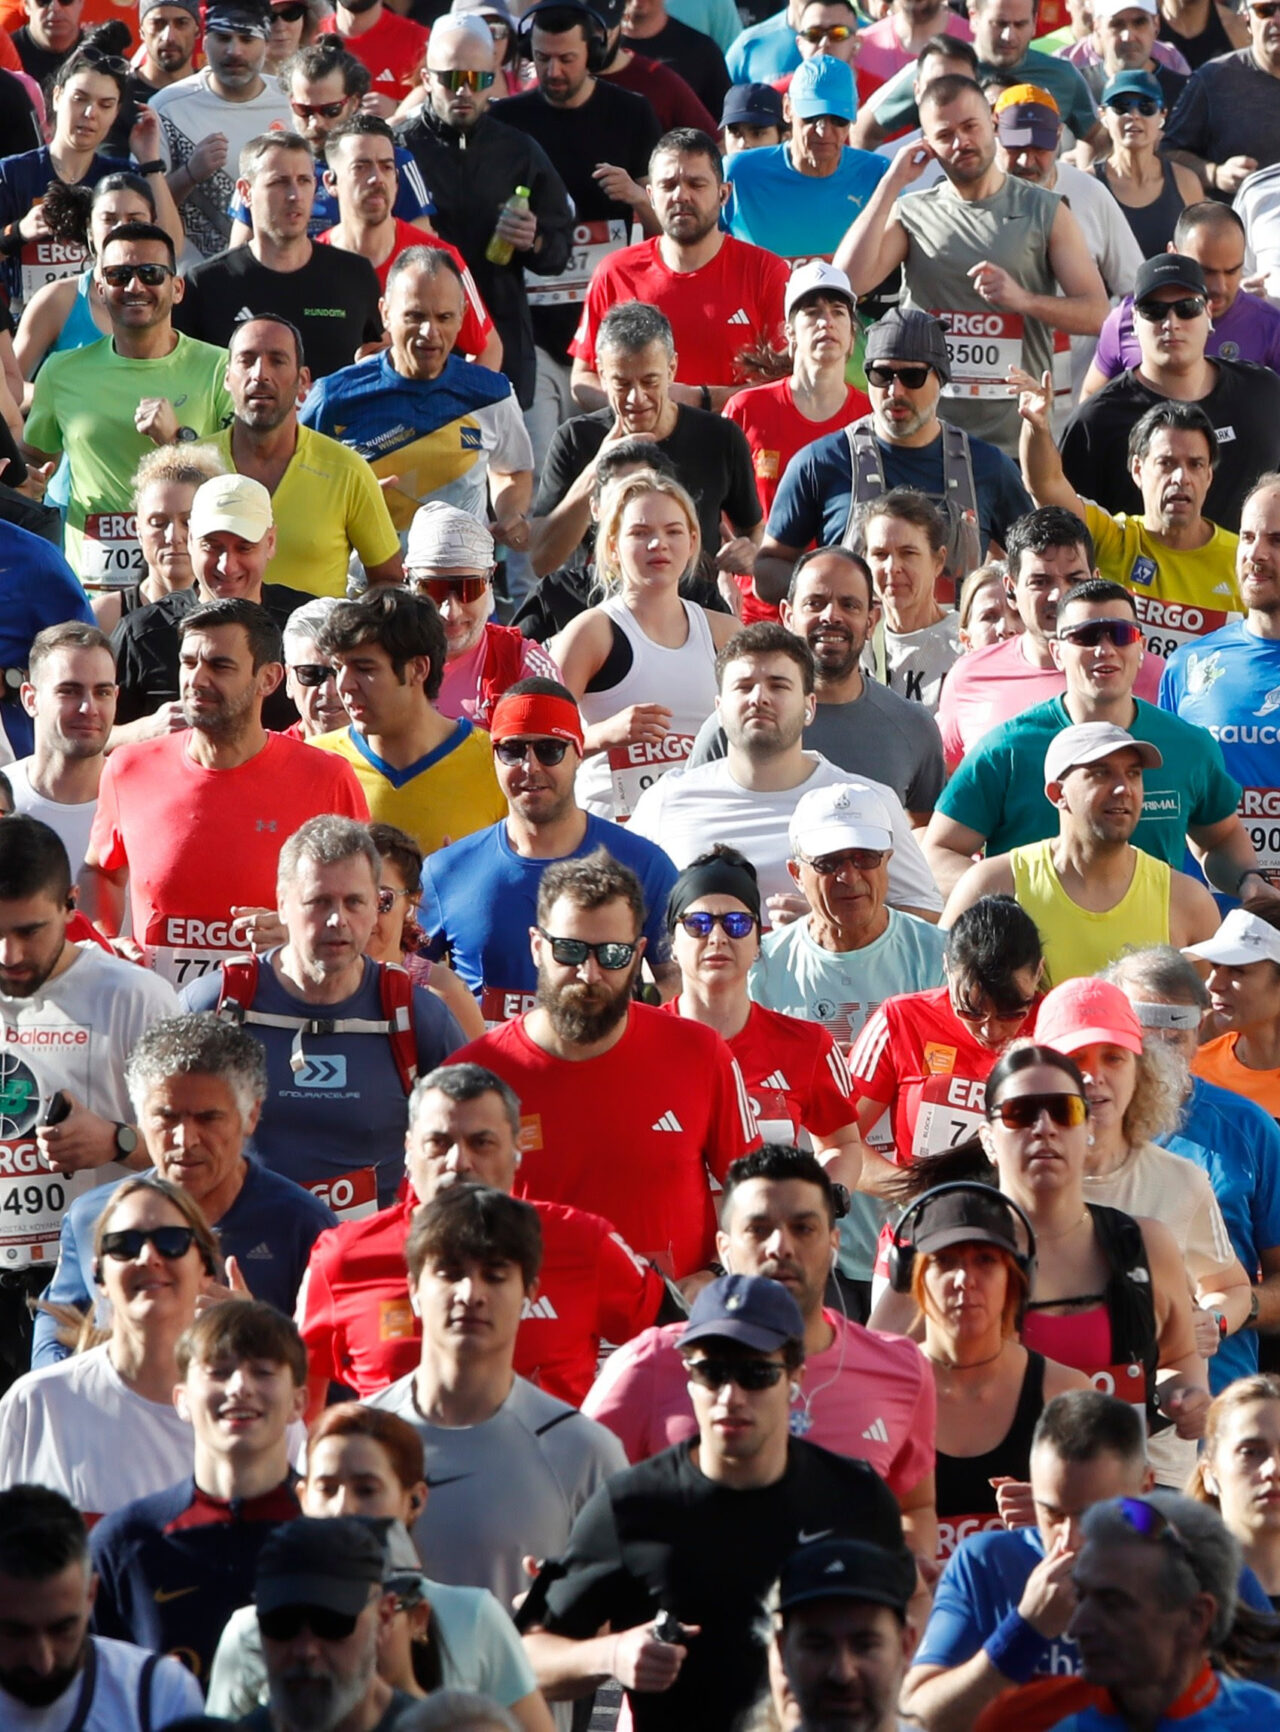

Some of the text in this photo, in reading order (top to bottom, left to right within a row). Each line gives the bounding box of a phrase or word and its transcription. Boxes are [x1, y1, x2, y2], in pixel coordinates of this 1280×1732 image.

[37, 243, 88, 263] ERG
[940, 313, 1004, 336] ERGO
[366, 424, 405, 448] RUNNING
[102, 548, 144, 570] 702
[1134, 595, 1204, 631] ERGO
[1147, 636, 1178, 660] 68
[628, 736, 696, 764] ERGO
[167, 917, 251, 948] ERGO
[174, 959, 222, 983] 77
[504, 993, 539, 1019] ER
[5, 1026, 88, 1045] balance
[948, 1077, 986, 1111] ER
[0, 1143, 53, 1174] RG
[3, 1183, 65, 1215] 490
[311, 1179, 354, 1207] GO
